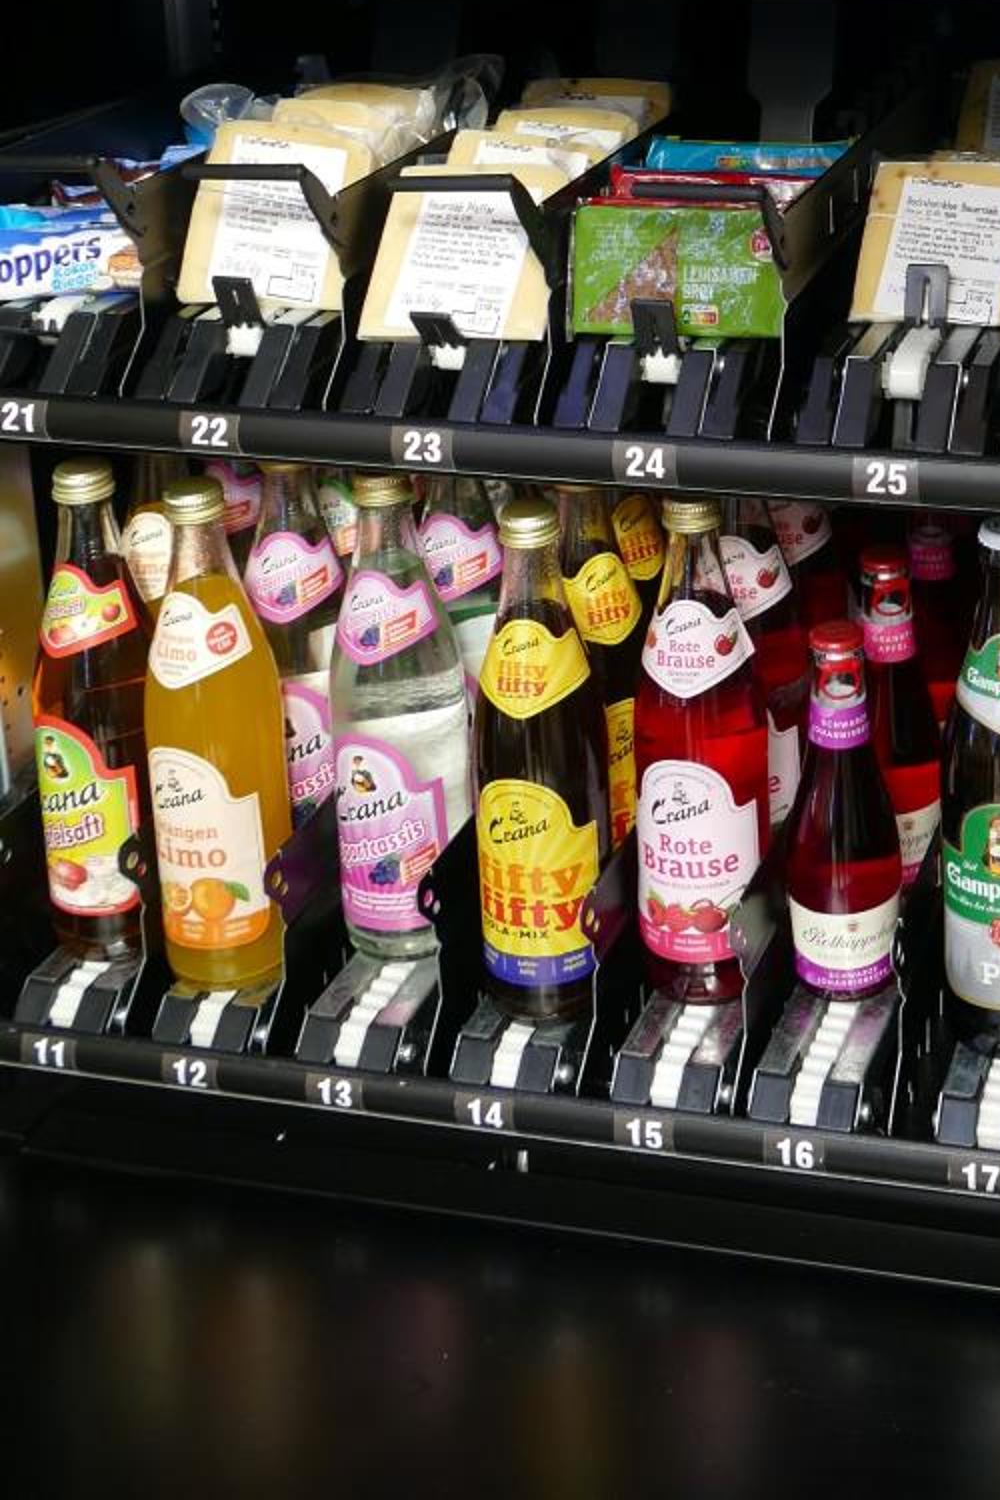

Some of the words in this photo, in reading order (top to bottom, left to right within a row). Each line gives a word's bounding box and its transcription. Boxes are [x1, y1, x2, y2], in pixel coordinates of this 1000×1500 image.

[1, 401, 36, 433] 21
[191, 415, 228, 447] 22
[404, 431, 442, 463] 23
[625, 447, 666, 479] 24
[866, 462, 907, 496] 25
[657, 650, 716, 669] Brause
[652, 799, 711, 825] Crana
[659, 833, 713, 855] Rote
[480, 853, 584, 898] fifty
[644, 842, 740, 880] Brause
[482, 882, 585, 932] fifty
[34, 1038, 65, 1067] 11
[172, 1057, 207, 1087] 12
[317, 1077, 352, 1107] 13
[467, 1097, 503, 1128] 14
[626, 1116, 670, 1148] 15
[776, 1137, 816, 1168] 16
[962, 1162, 1000, 1192] 17
